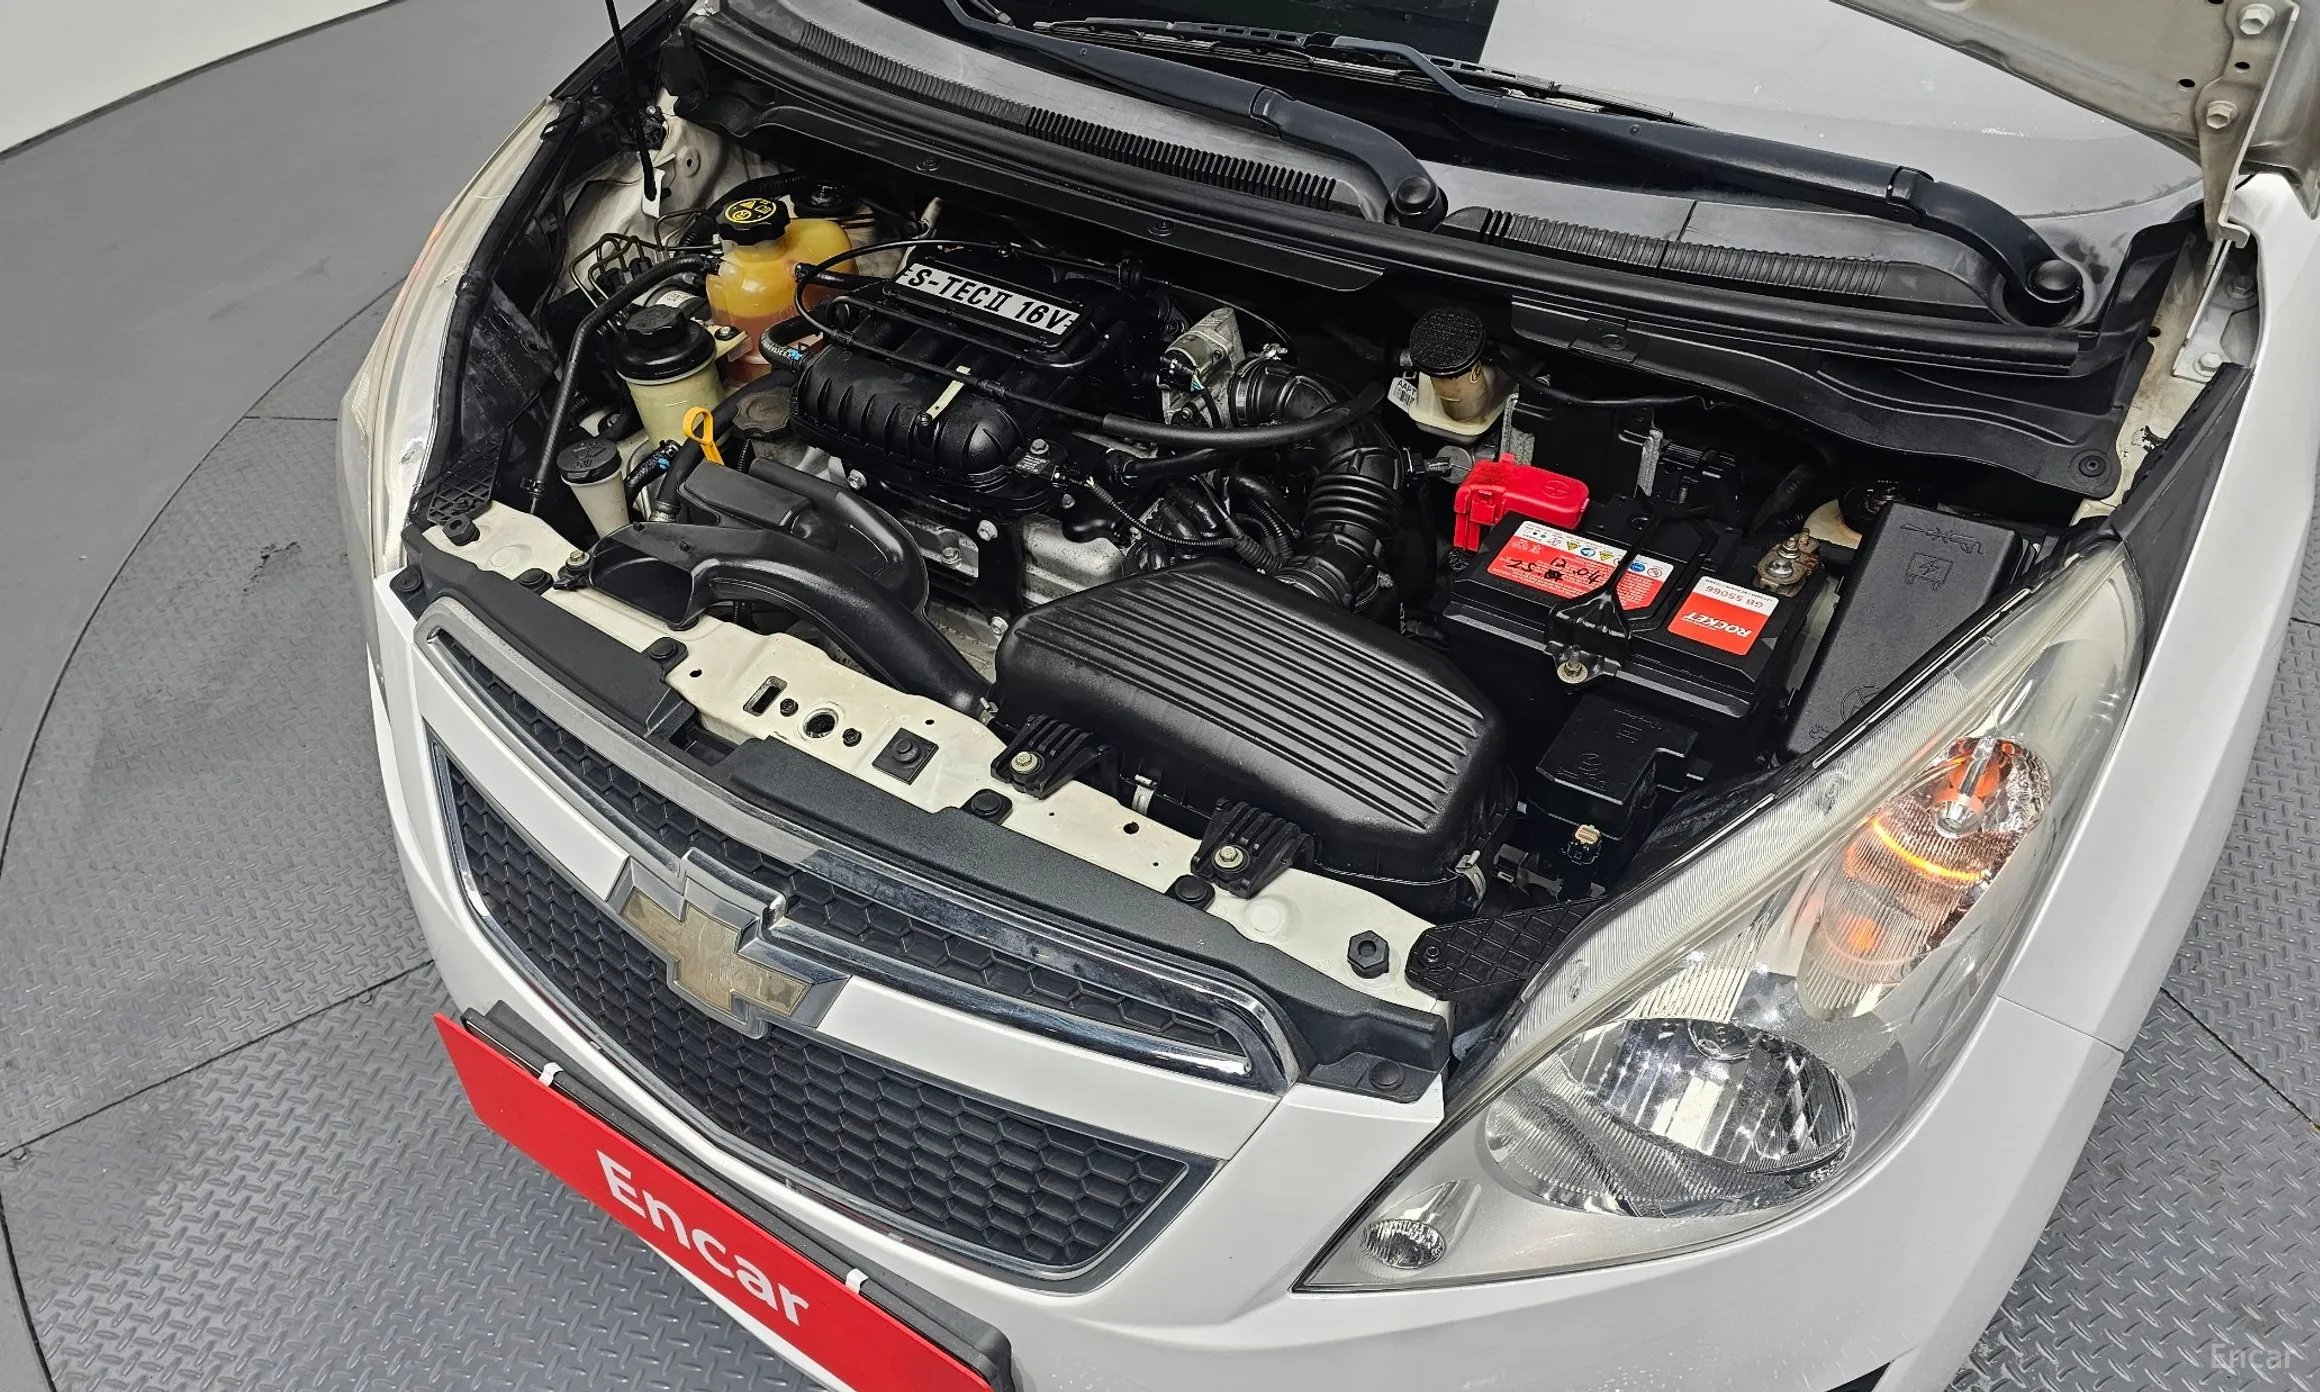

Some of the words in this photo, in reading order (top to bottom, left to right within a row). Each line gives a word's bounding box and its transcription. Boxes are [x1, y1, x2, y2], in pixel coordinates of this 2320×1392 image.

[1015, 301, 1071, 330] 16V
[1682, 611, 1753, 638] ROCKET
[595, 1148, 810, 1326] Encar
